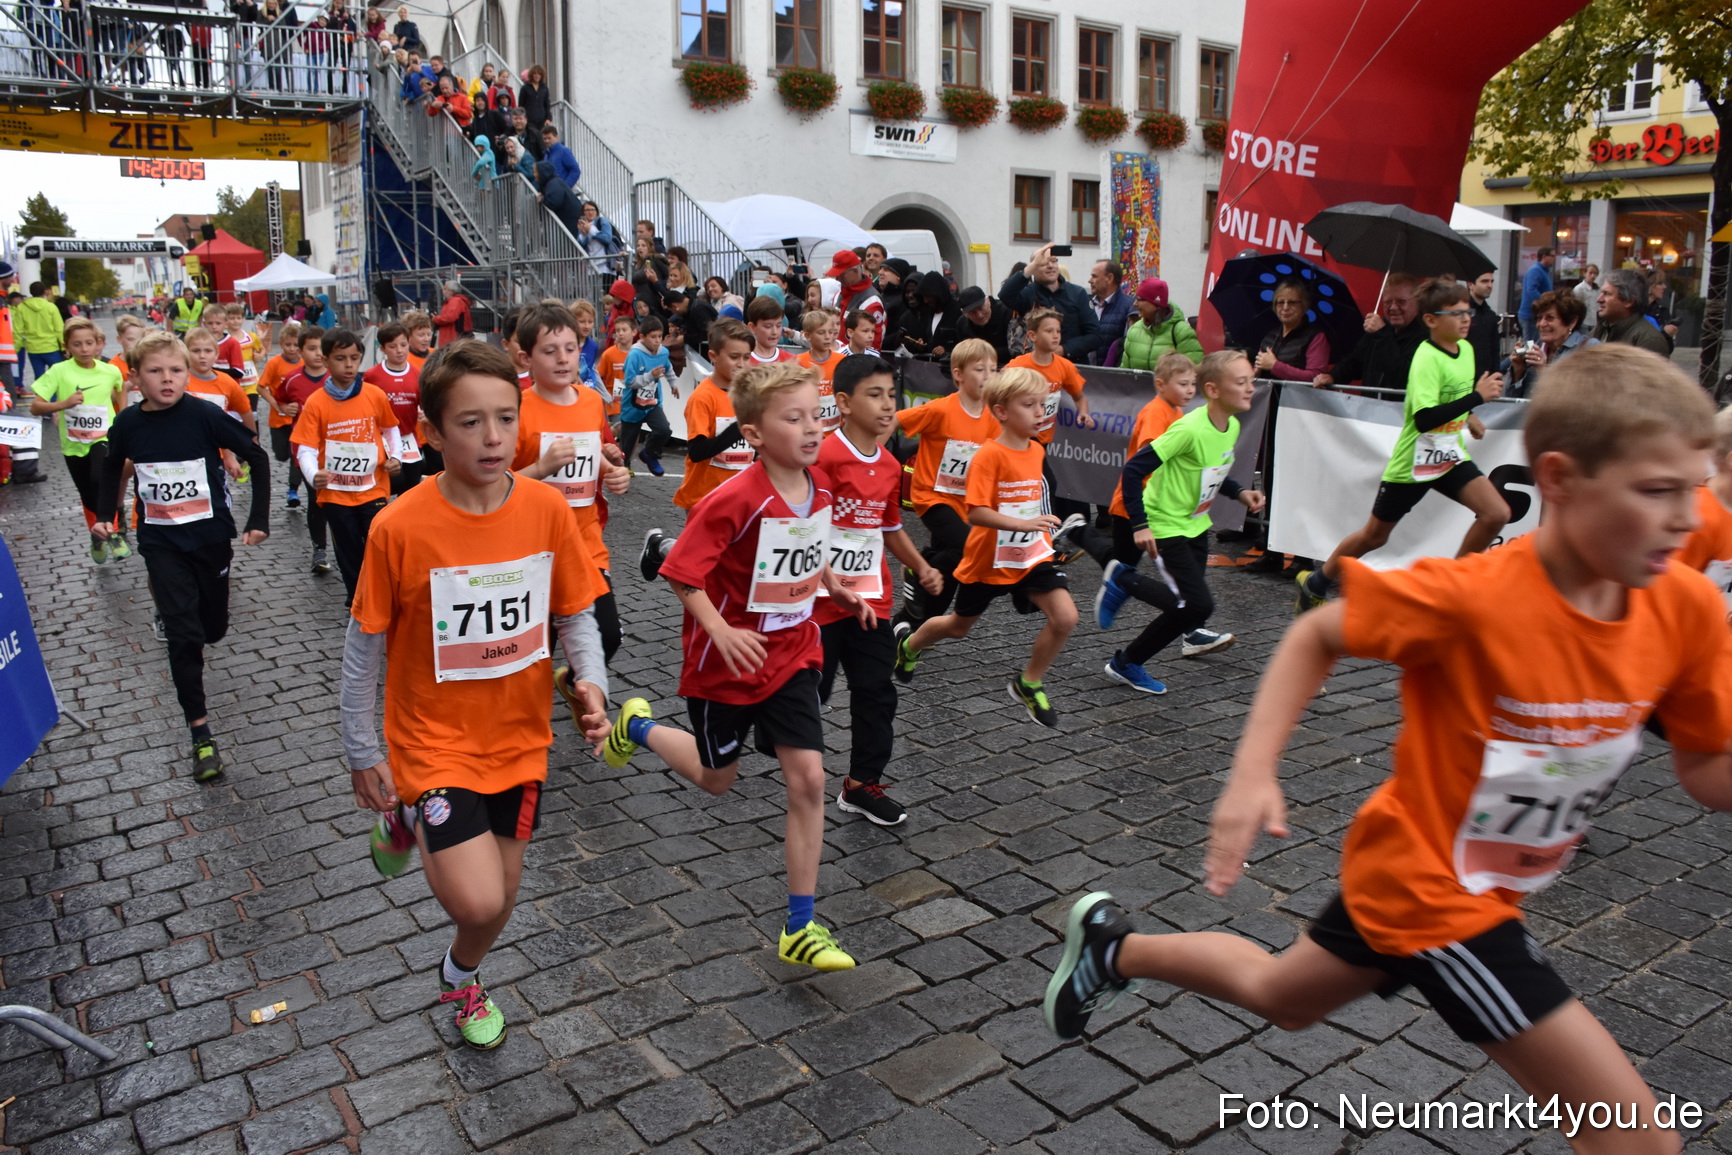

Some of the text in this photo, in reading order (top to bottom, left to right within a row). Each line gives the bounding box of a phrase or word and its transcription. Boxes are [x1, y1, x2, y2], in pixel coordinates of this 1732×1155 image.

[109, 121, 194, 151] ZIEL
[874, 125, 916, 143] swn
[1228, 129, 1320, 178] STORE
[1588, 139, 1639, 163] Der
[1218, 202, 1324, 257] ONLINE
[54, 241, 83, 251] MINI
[820, 404, 838, 418] 217
[71, 416, 102, 428] 7099
[333, 457, 370, 473] 7227
[949, 458, 968, 475] 71
[147, 480, 199, 501] 7323
[565, 486, 585, 495] David
[830, 547, 874, 572] 7023
[482, 570, 524, 585] BOCK
[452, 590, 531, 637] 7151
[481, 642, 519, 660] Jakob
